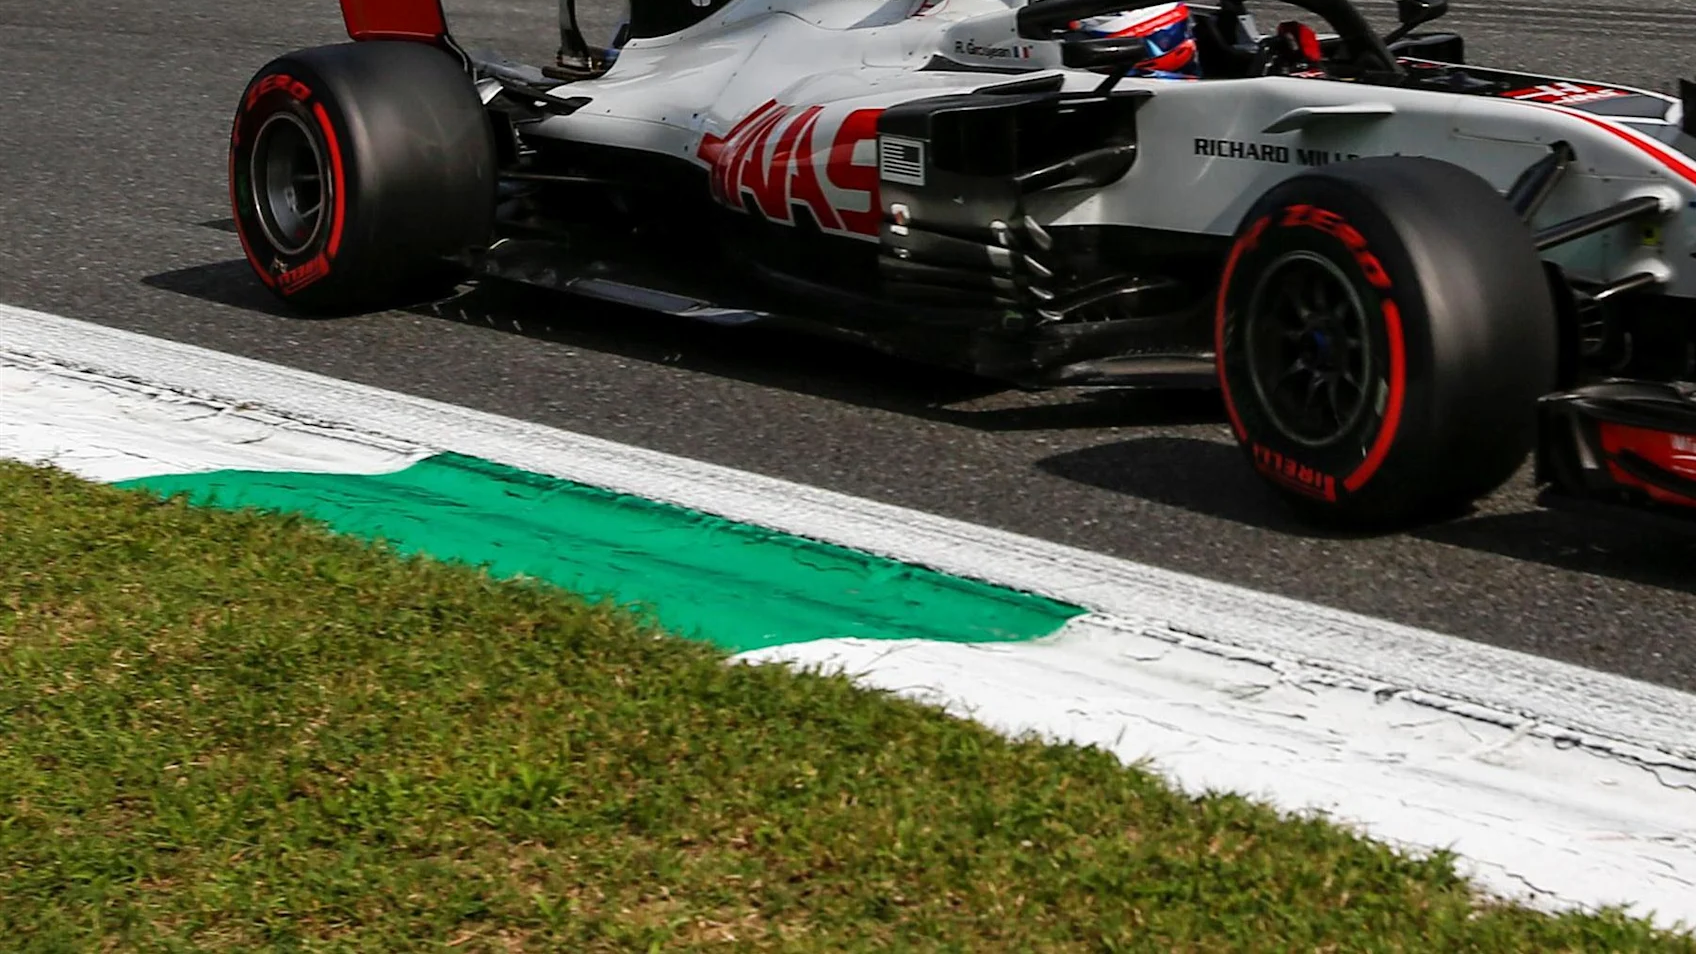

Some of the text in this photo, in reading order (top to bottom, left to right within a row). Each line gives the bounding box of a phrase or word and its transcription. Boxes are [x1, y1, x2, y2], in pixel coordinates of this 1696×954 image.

[697, 98, 885, 242] HAAS
[1193, 138, 1290, 164] RICHARD
[1279, 204, 1392, 288] ZERO
